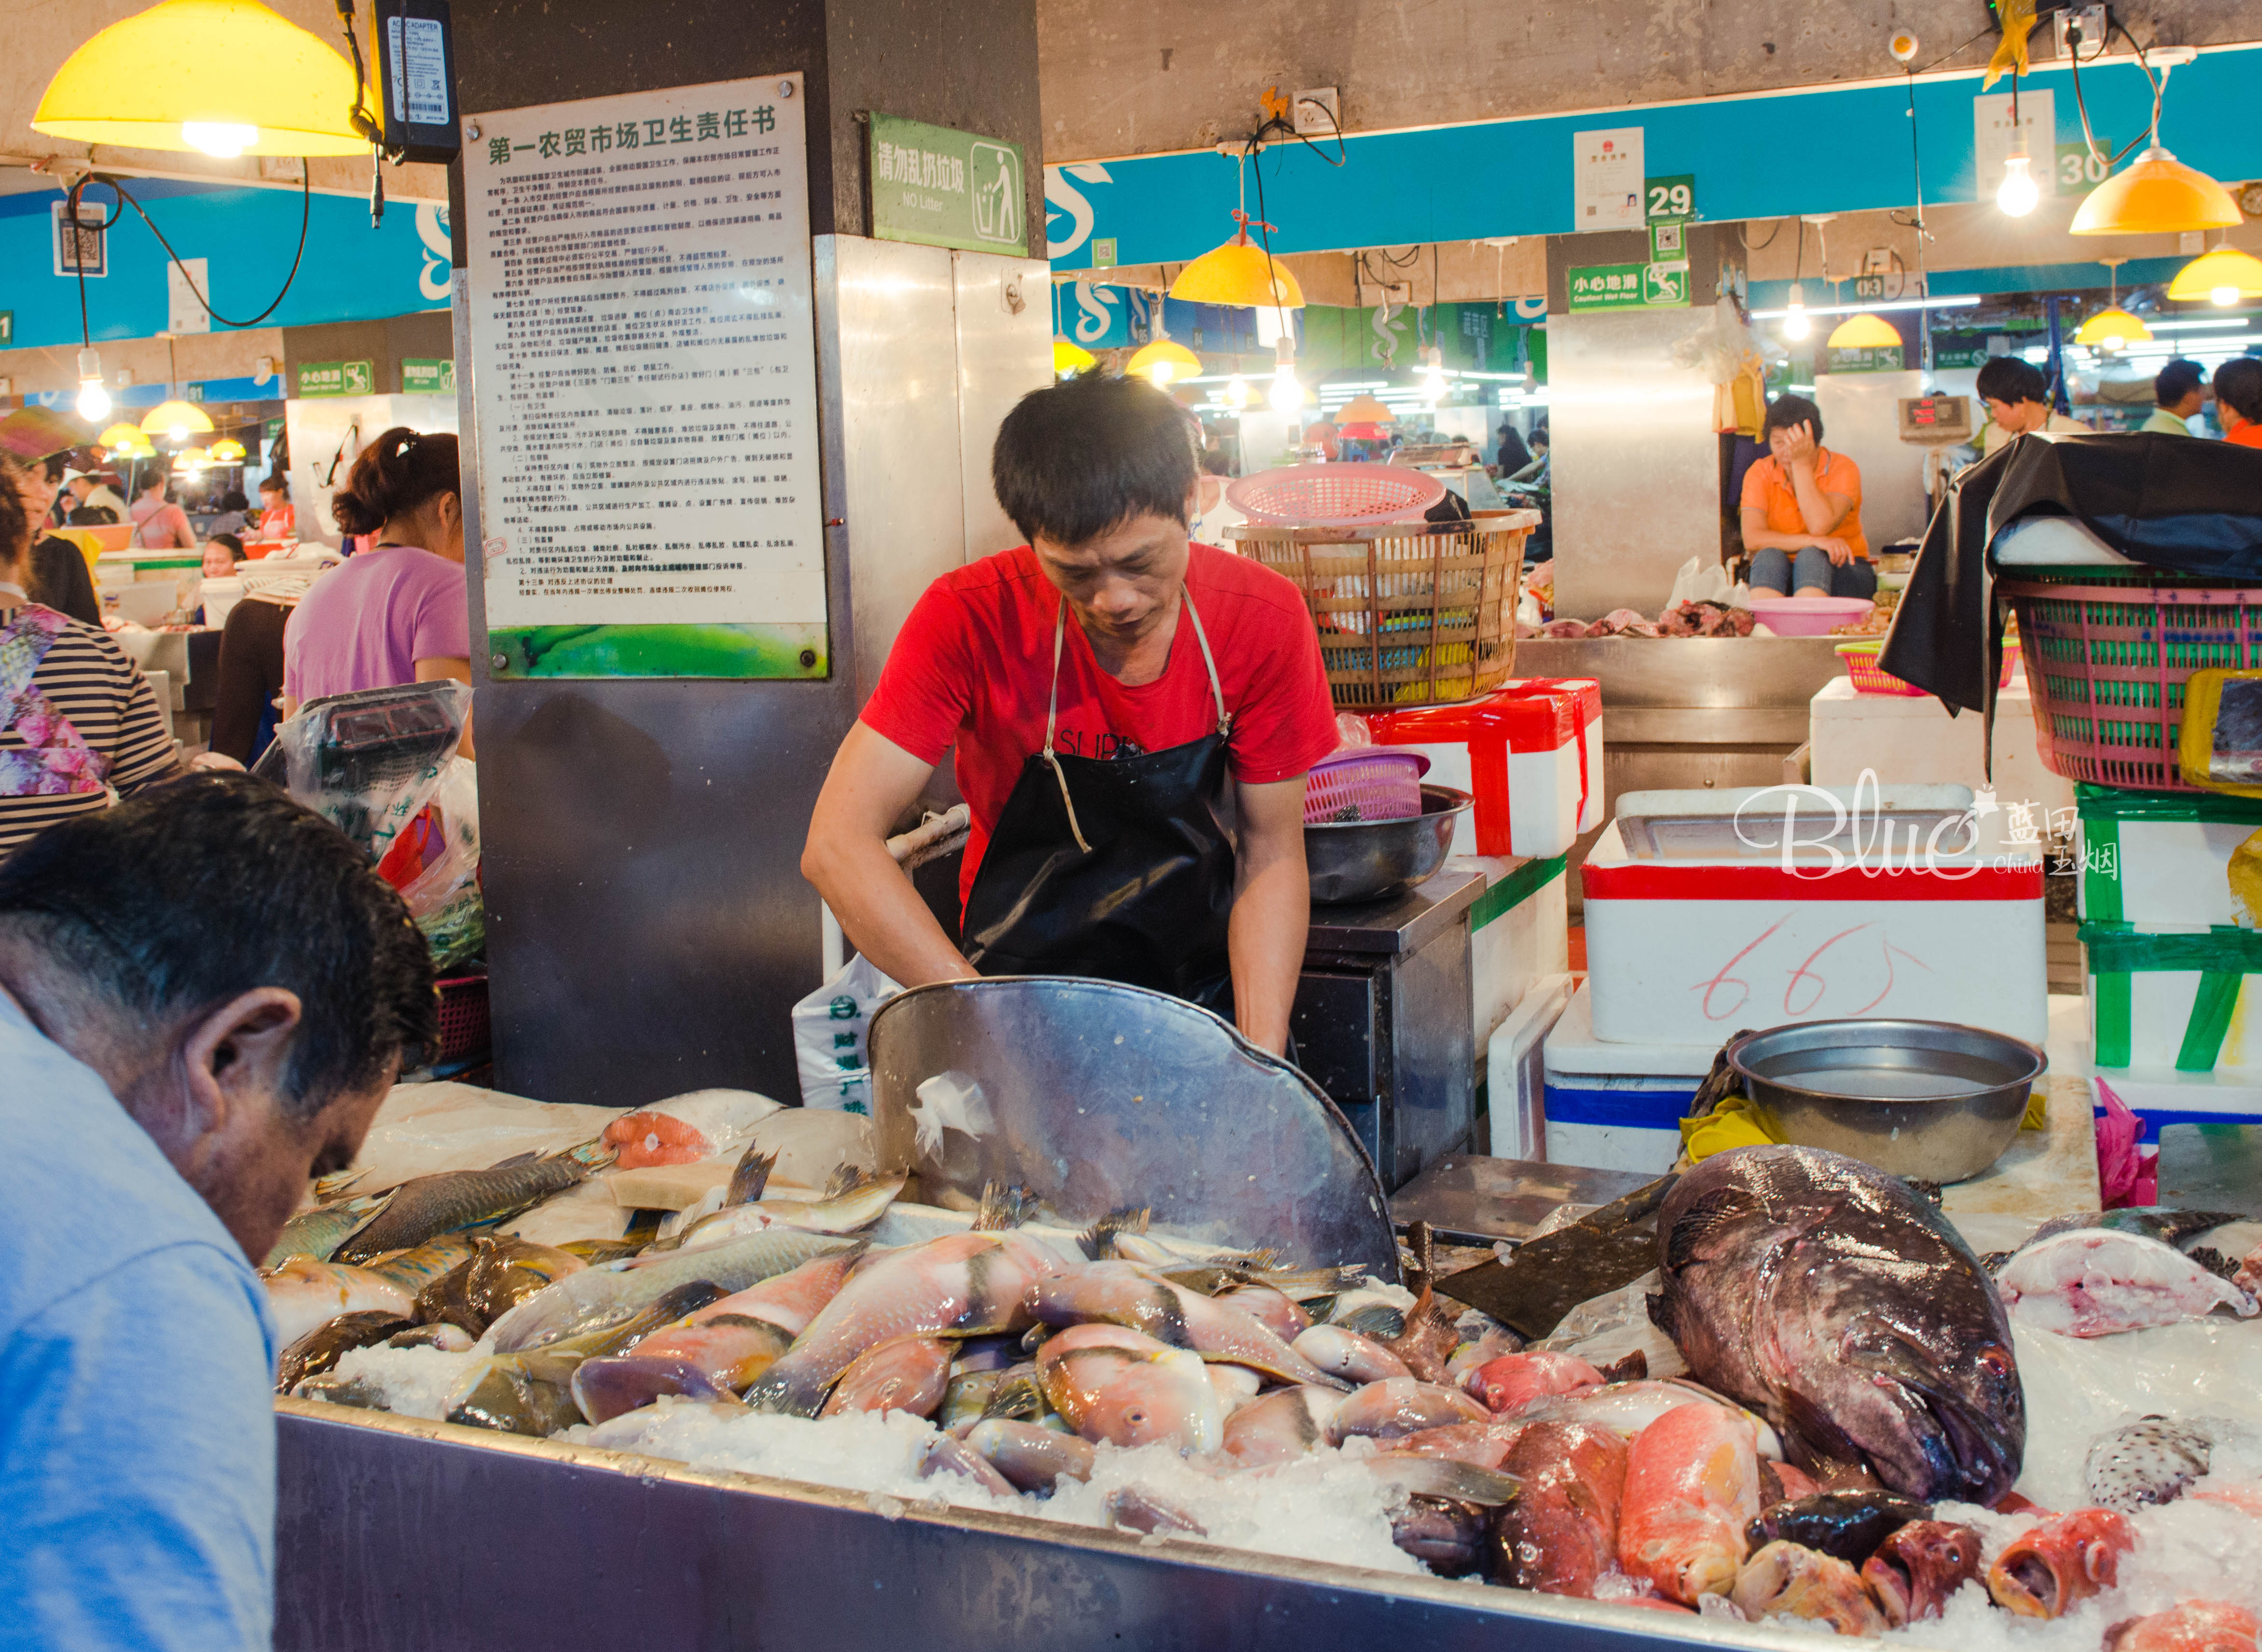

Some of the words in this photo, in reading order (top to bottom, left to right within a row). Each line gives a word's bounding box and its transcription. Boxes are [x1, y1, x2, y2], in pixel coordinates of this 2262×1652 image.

[412, 22, 438, 30] ADAPTER
[488, 105, 776, 166] 第一农贸市场卫生责任书
[878, 141, 965, 194] 请勿乱扔垃圾
[2060, 151, 2109, 185] 30
[903, 192, 917, 207] NO
[920, 195, 943, 212] Litter
[1648, 184, 1691, 216] 29
[1573, 274, 1638, 293] 小心地滑
